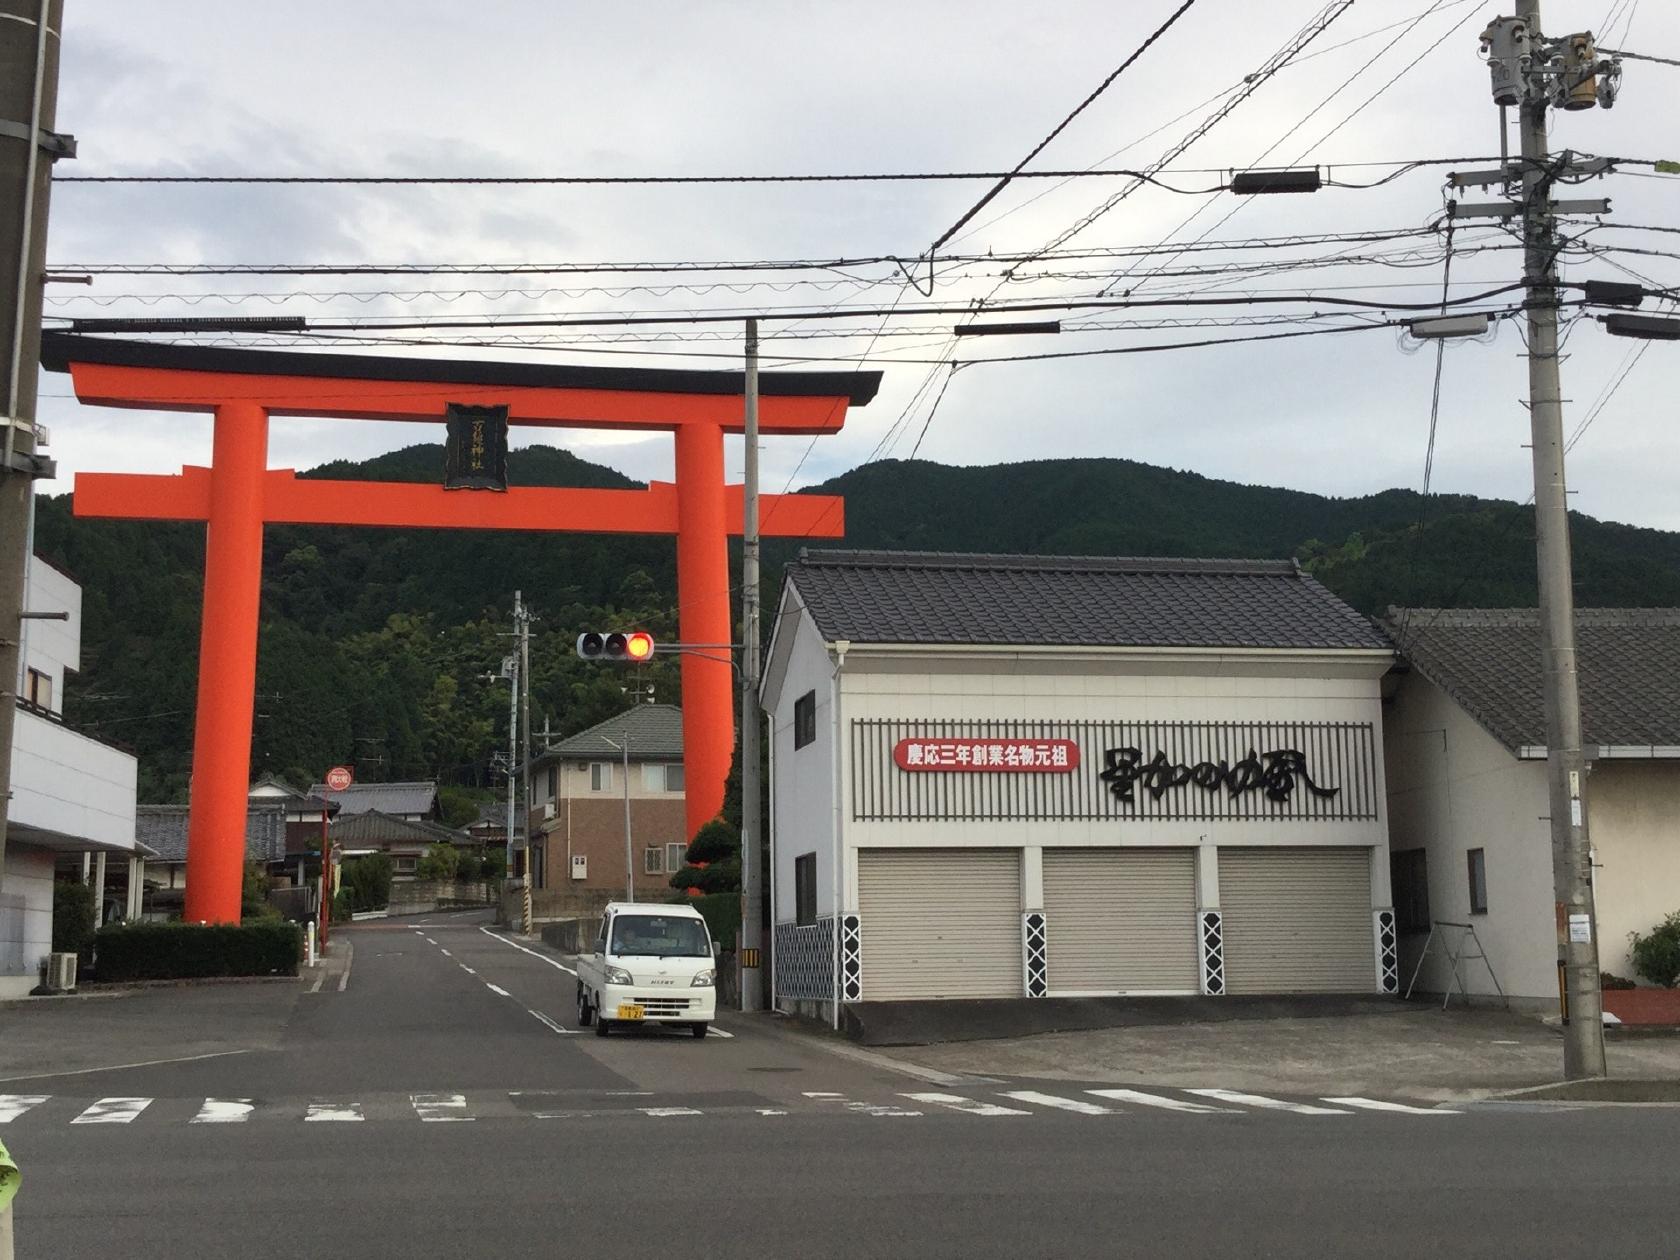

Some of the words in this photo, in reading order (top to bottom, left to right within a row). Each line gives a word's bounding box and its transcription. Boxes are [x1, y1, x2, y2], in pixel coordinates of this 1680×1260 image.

[906, 744, 1068, 766] 慶応三年創業名物元祖
